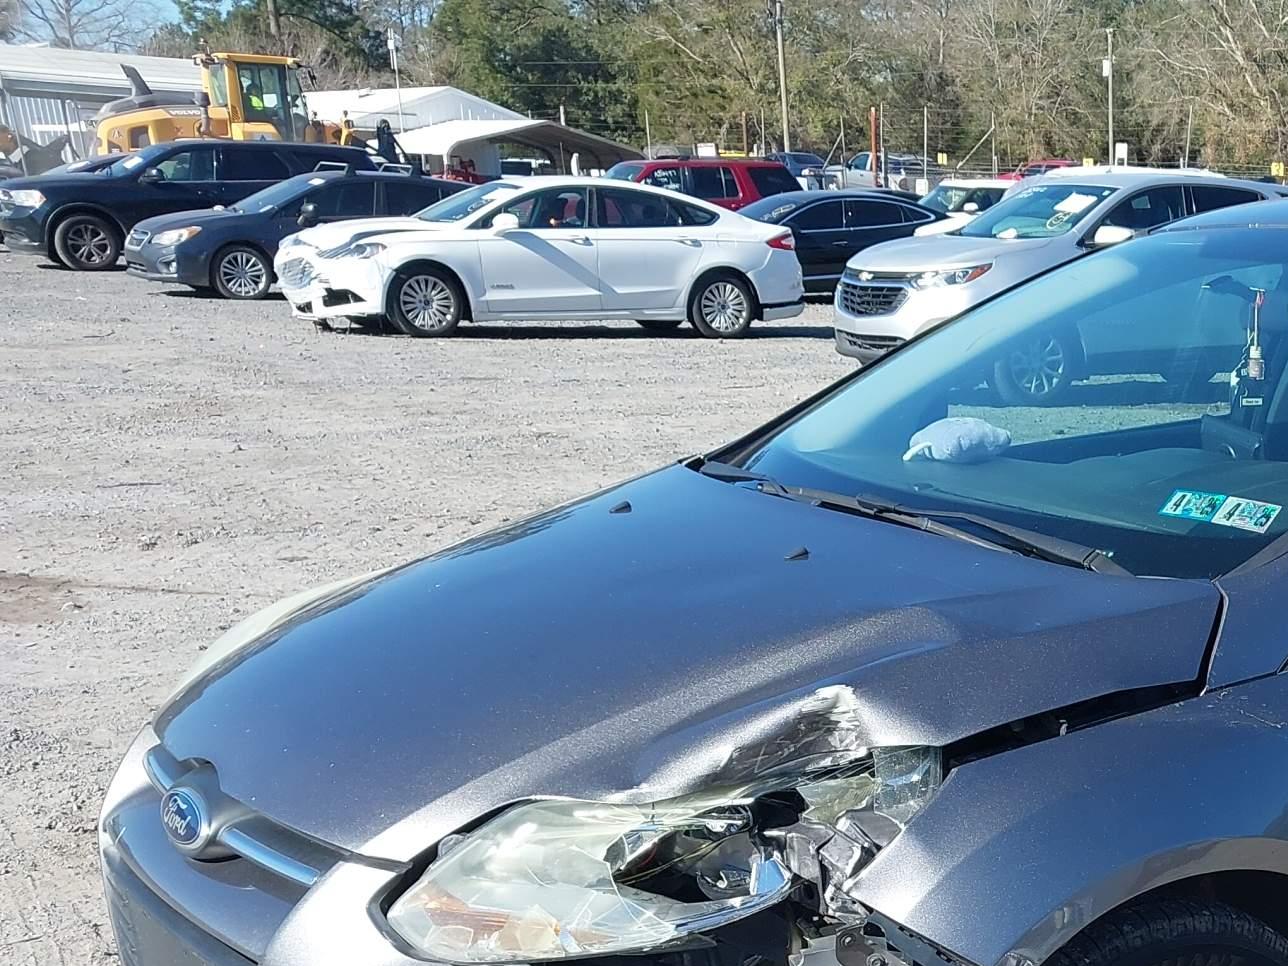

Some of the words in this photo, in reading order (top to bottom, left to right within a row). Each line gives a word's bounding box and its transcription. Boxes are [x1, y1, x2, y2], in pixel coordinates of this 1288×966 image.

[1170, 493, 1188, 512] 4
[1223, 502, 1243, 521] 4
[163, 795, 192, 836] Ford
